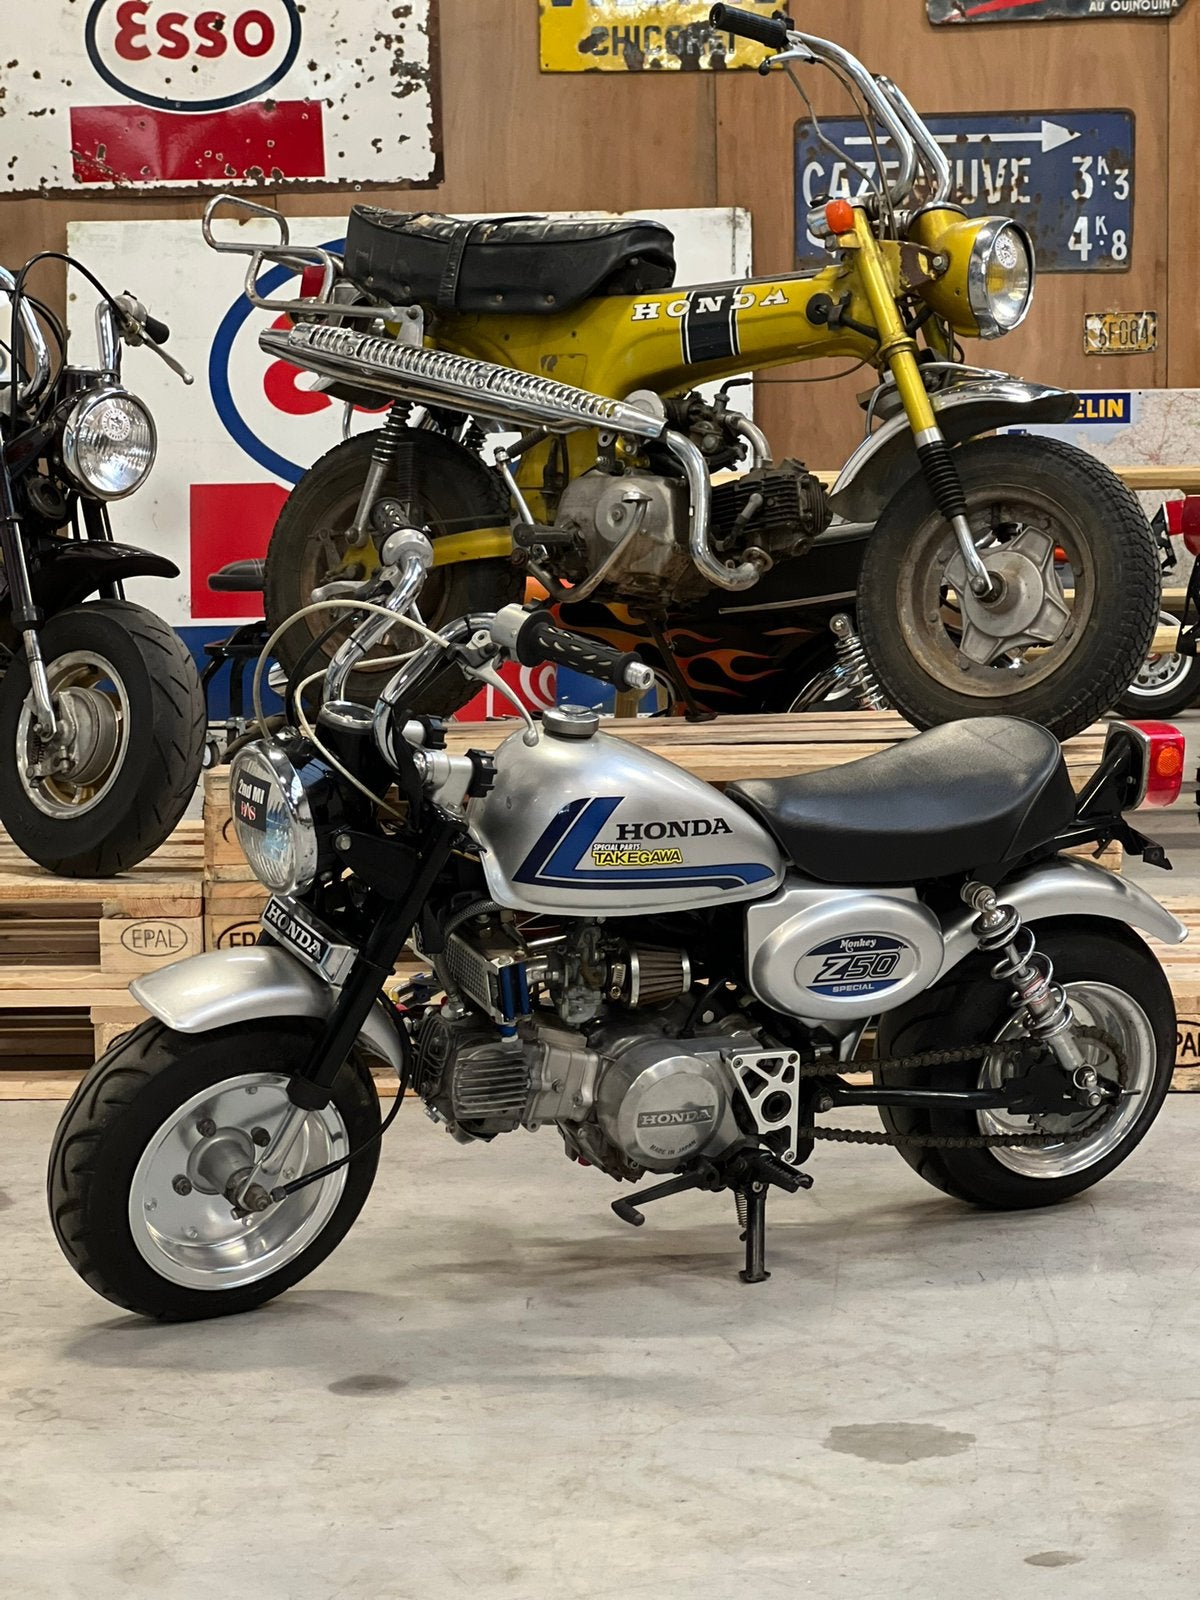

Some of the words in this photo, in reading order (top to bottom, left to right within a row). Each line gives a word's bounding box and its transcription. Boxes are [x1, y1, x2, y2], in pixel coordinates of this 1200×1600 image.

[1088, 1, 1105, 12] AU
[631, 288, 789, 321] HONDA
[1072, 399, 1124, 418] ELIN
[616, 817, 733, 841] HONDA
[593, 843, 618, 851] SPECIAL
[619, 843, 641, 851] PARTS
[594, 849, 682, 866] TAKEGAWA
[132, 929, 179, 948] EPAL
[266, 903, 322, 960] HONDA
[839, 938, 877, 952] Monkey
[812, 951, 901, 984] Z50
[832, 983, 875, 993] SPECIAL
[641, 1108, 712, 1125] HONDA
[649, 1143, 666, 1155] MADE
[677, 1139, 697, 1153] JAPAN
